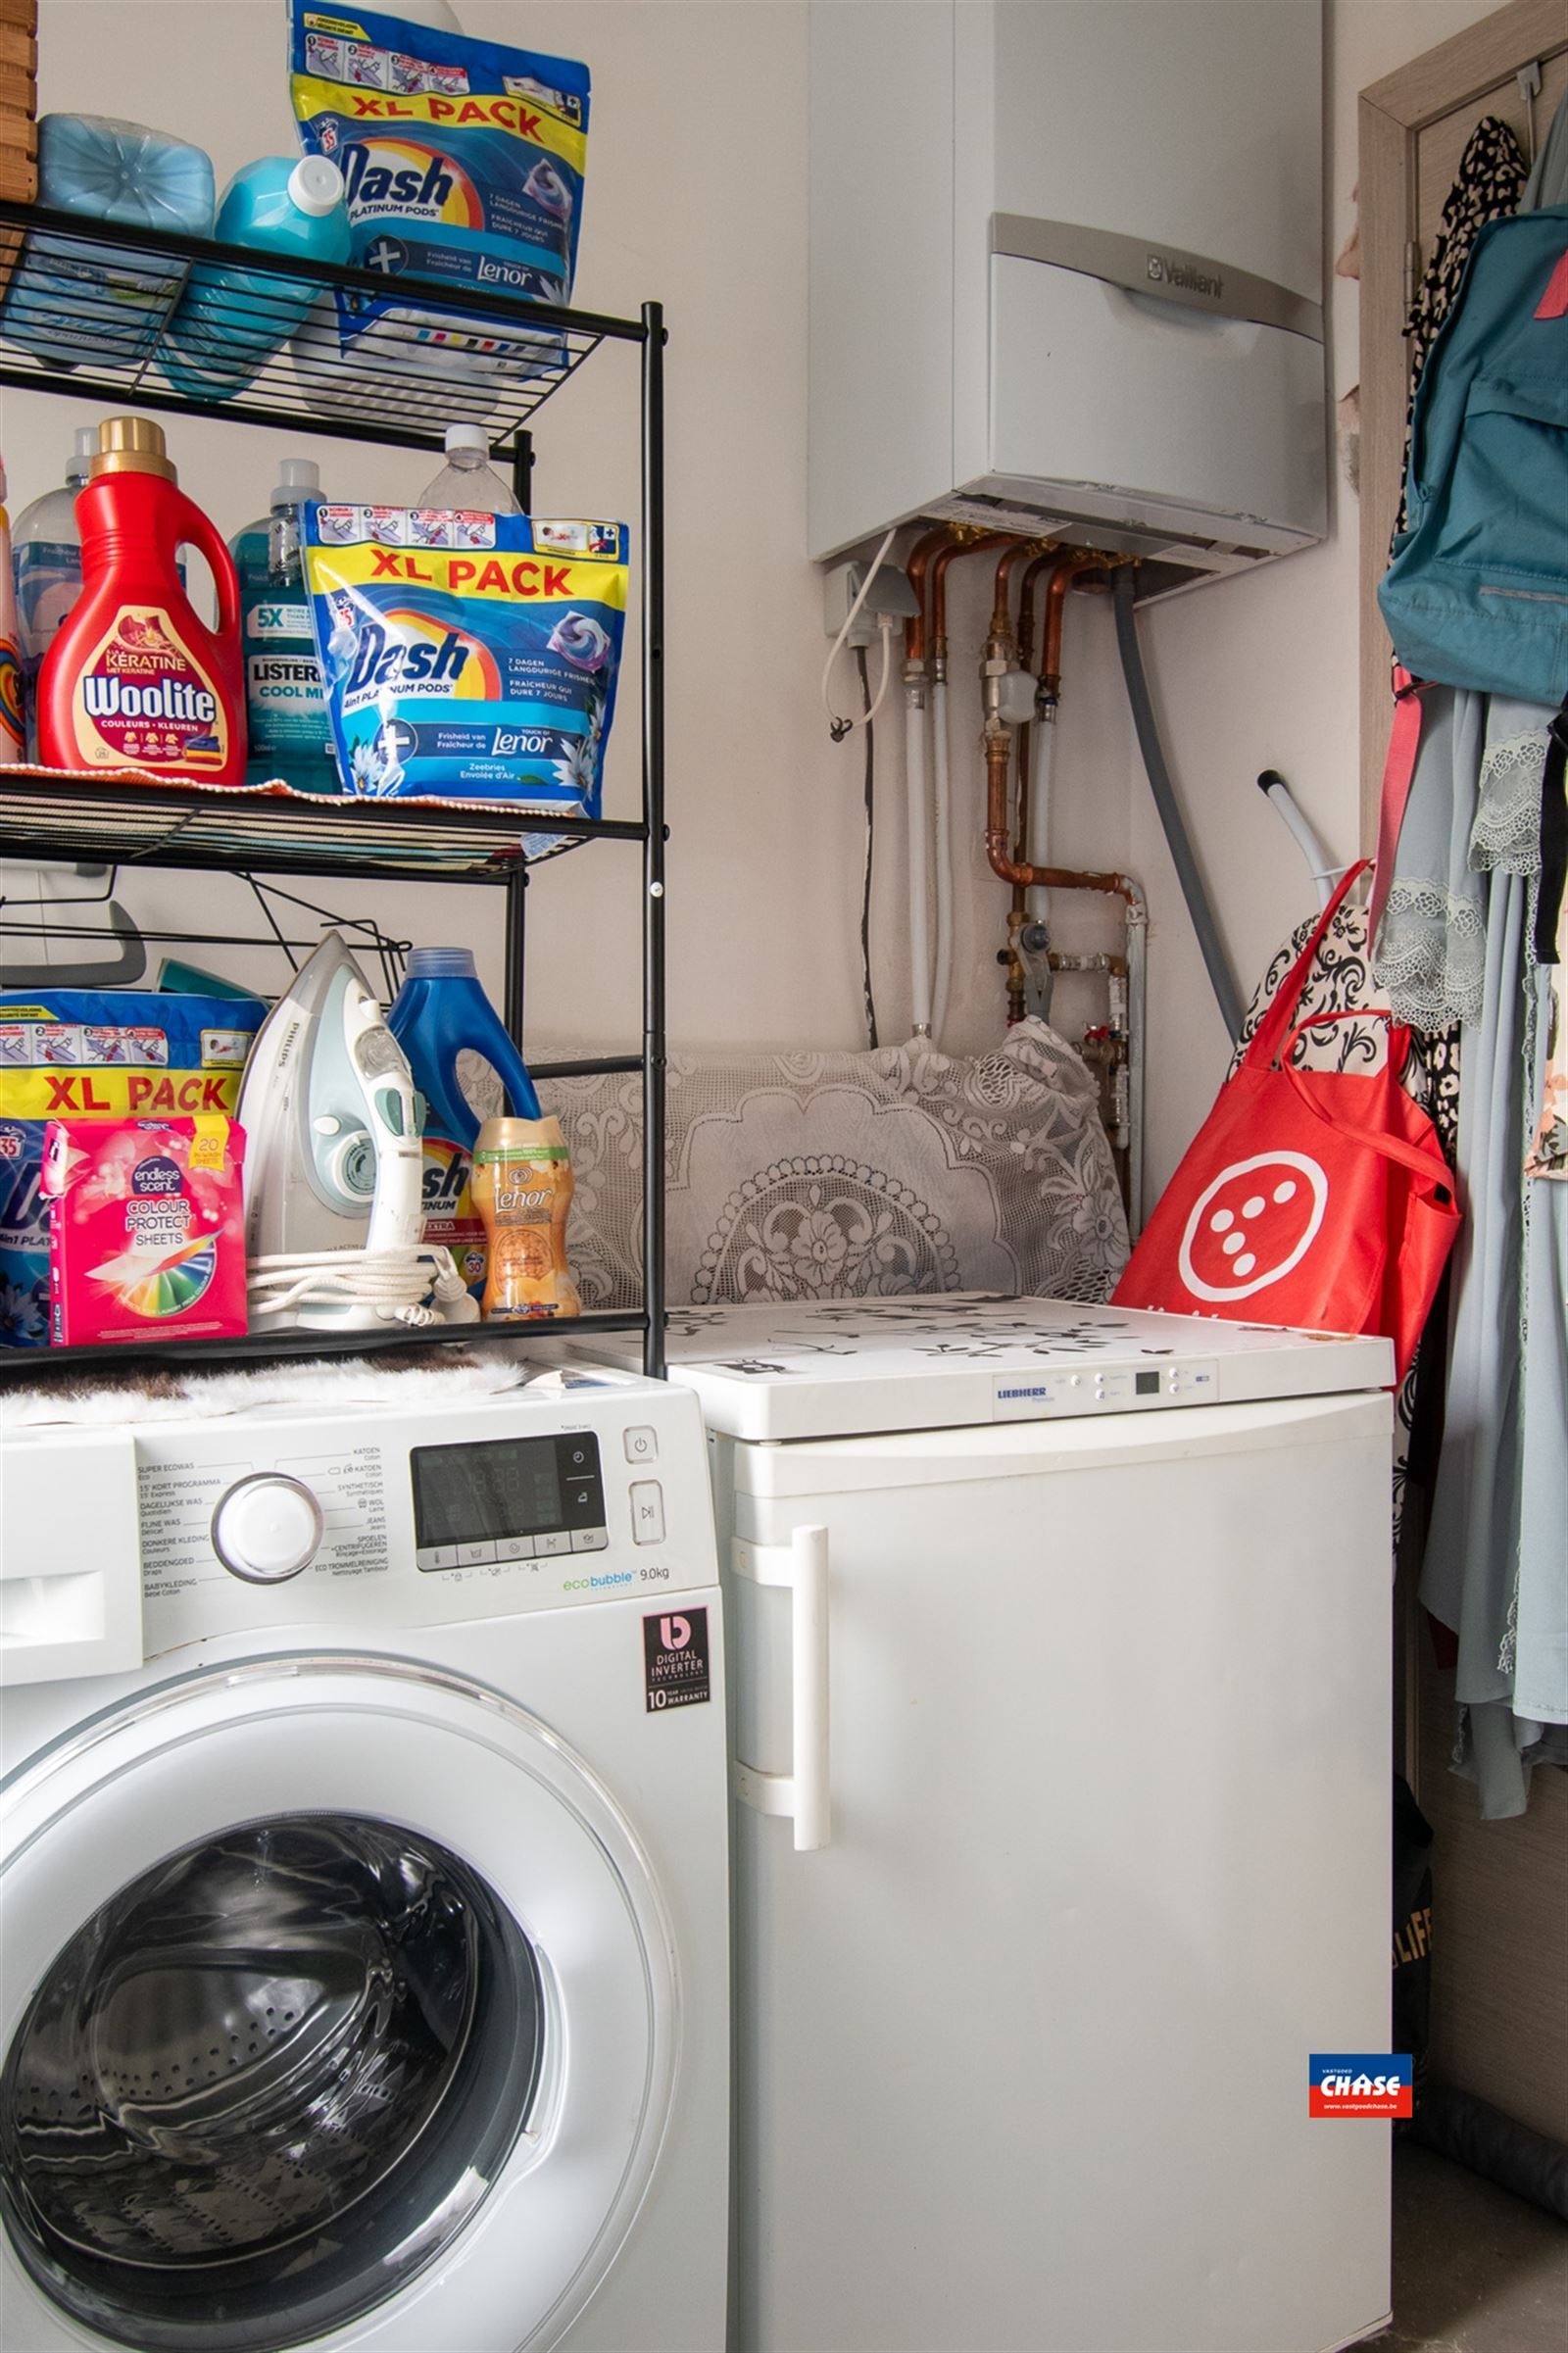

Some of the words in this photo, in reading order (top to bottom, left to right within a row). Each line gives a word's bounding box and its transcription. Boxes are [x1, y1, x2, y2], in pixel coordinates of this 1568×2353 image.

[351, 95, 414, 117] XL
[427, 98, 545, 144] PACK
[340, 142, 455, 209] Dash
[405, 206, 437, 218] PODS
[476, 255, 533, 286] Lenor
[1162, 256, 1224, 299] Vaillant
[370, 550, 432, 581] XL
[449, 560, 574, 596] PACK
[258, 608, 283, 628] 5X
[106, 652, 186, 672] KÉRATINE
[345, 623, 469, 695] Dash
[514, 658, 545, 666] DAGEN
[508, 665, 562, 677] LANGDURIGE
[259, 686, 303, 698] COOL
[416, 683, 451, 693] PODS
[510, 679, 557, 690] FRAÎCHEUR
[558, 685, 572, 695] QUI
[84, 675, 217, 723] Woolite
[510, 688, 533, 697] DURE
[543, 691, 567, 702] JOURS
[101, 720, 150, 729] COULEURS
[158, 722, 198, 732] KLEUREN
[438, 732, 470, 741] Frisheid
[491, 727, 553, 756] Lenor
[468, 762, 506, 771] Zeebries
[278, 1022, 300, 1067] PHILIPS
[45, 1076, 110, 1111] XL
[128, 1077, 229, 1111] PACK
[0, 1138, 17, 1155] 35
[199, 1138, 220, 1152] 20
[134, 1167, 180, 1182] endless
[140, 1178, 176, 1192] scent
[494, 1185, 552, 1214] Lenor
[127, 1201, 189, 1215] COLOUR
[126, 1215, 190, 1230] PROTECT
[135, 1232, 183, 1246] SHEETS
[467, 1262, 481, 1273] 30
[998, 1387, 1047, 1399] LIEBHERR
[164, 1462, 194, 1472] ECOWAS
[172, 1478, 220, 1489] PROGRAMMA
[337, 1481, 383, 1492] SYNTHETISCH
[164, 1518, 180, 1527] WAS
[367, 1516, 385, 1525] JEANS
[141, 1537, 176, 1548] DONKERE
[178, 1534, 209, 1544] KLEDING
[143, 1556, 195, 1569] BEDDENGOED
[315, 1563, 328, 1572] ECO
[328, 1557, 388, 1570] TROMMELREINIGING
[640, 1567, 670, 1581] 9.0kg
[144, 1578, 198, 1591] BABYKLEDING
[657, 1650, 697, 1665] DIGITAL
[651, 1659, 703, 1677] INVERTER
[648, 1689, 666, 1709] 10
[667, 1691, 708, 1705] WARRANTY
